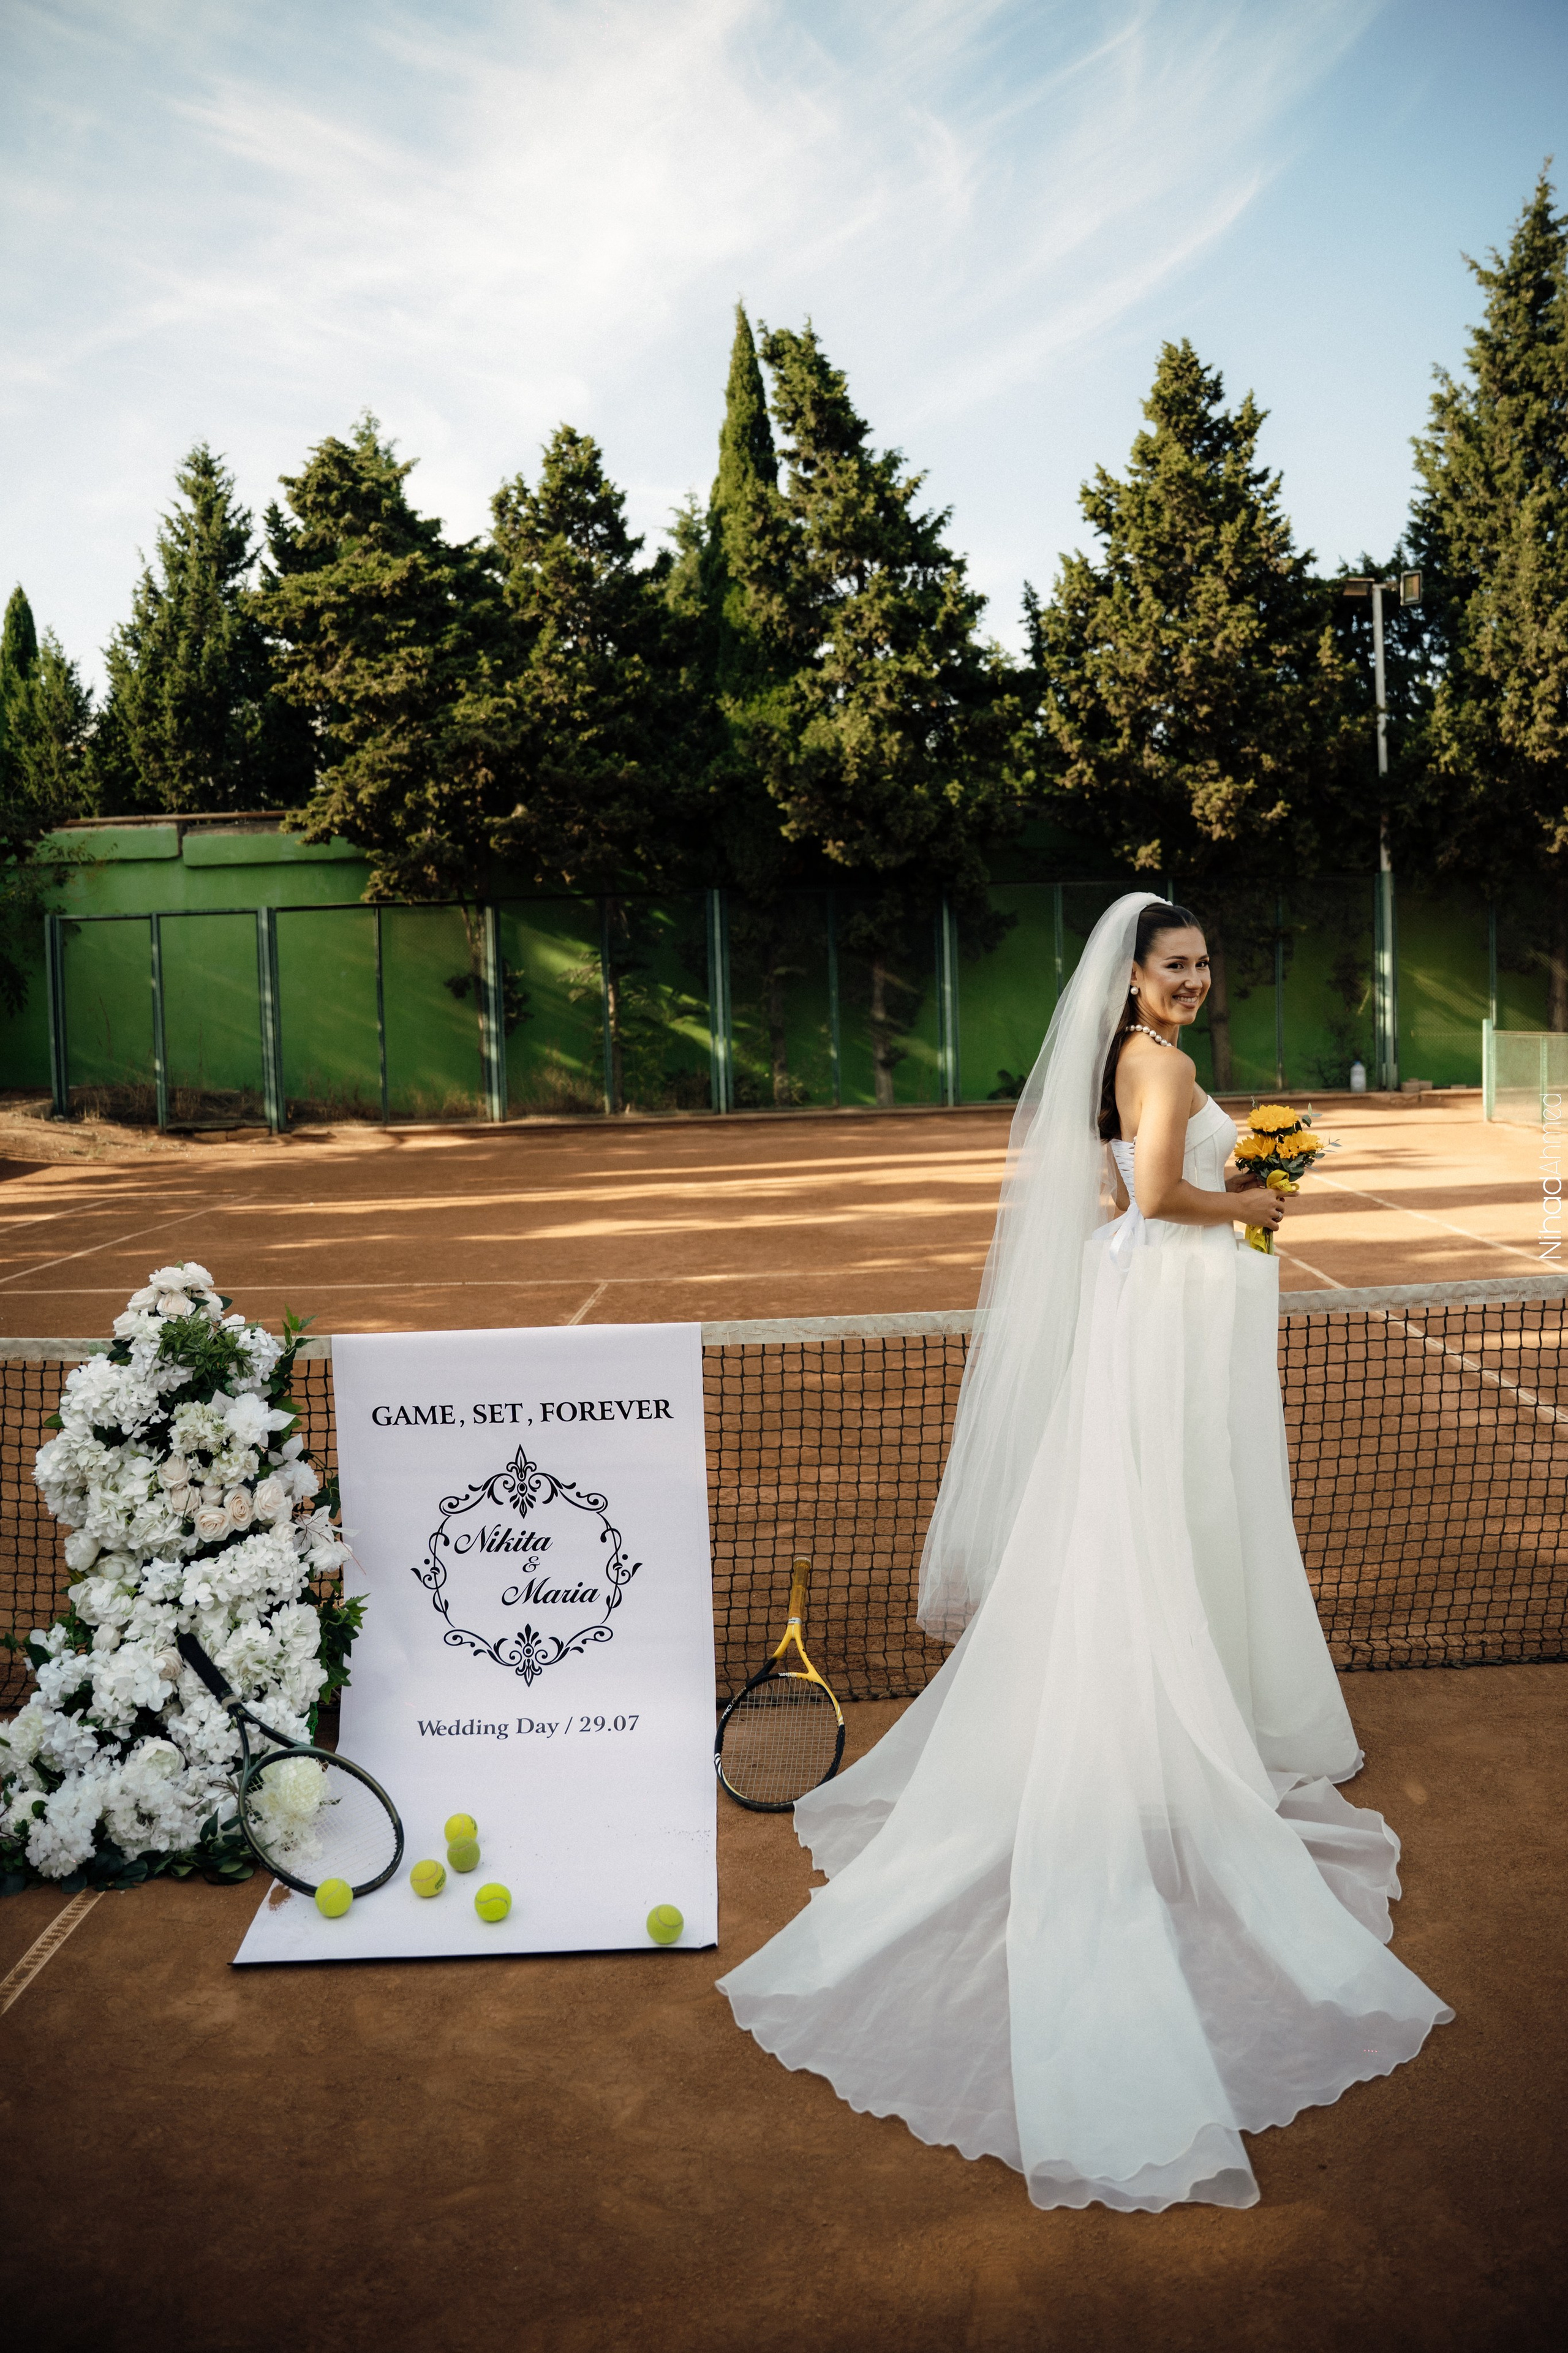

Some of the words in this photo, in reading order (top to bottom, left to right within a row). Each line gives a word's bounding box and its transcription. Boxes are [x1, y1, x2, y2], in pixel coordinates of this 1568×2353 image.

[371, 1404, 465, 1428] GAME,
[472, 1402, 533, 1427] SET,
[539, 1399, 674, 1422] FOREVER
[454, 1524, 553, 1555] Nikita
[522, 1555, 541, 1573] &
[501, 1576, 601, 1606] Maria
[417, 1719, 509, 1740] Wedding
[516, 1718, 560, 1739] Day
[564, 1717, 573, 1734] /
[579, 1715, 639, 1733] 29.07
